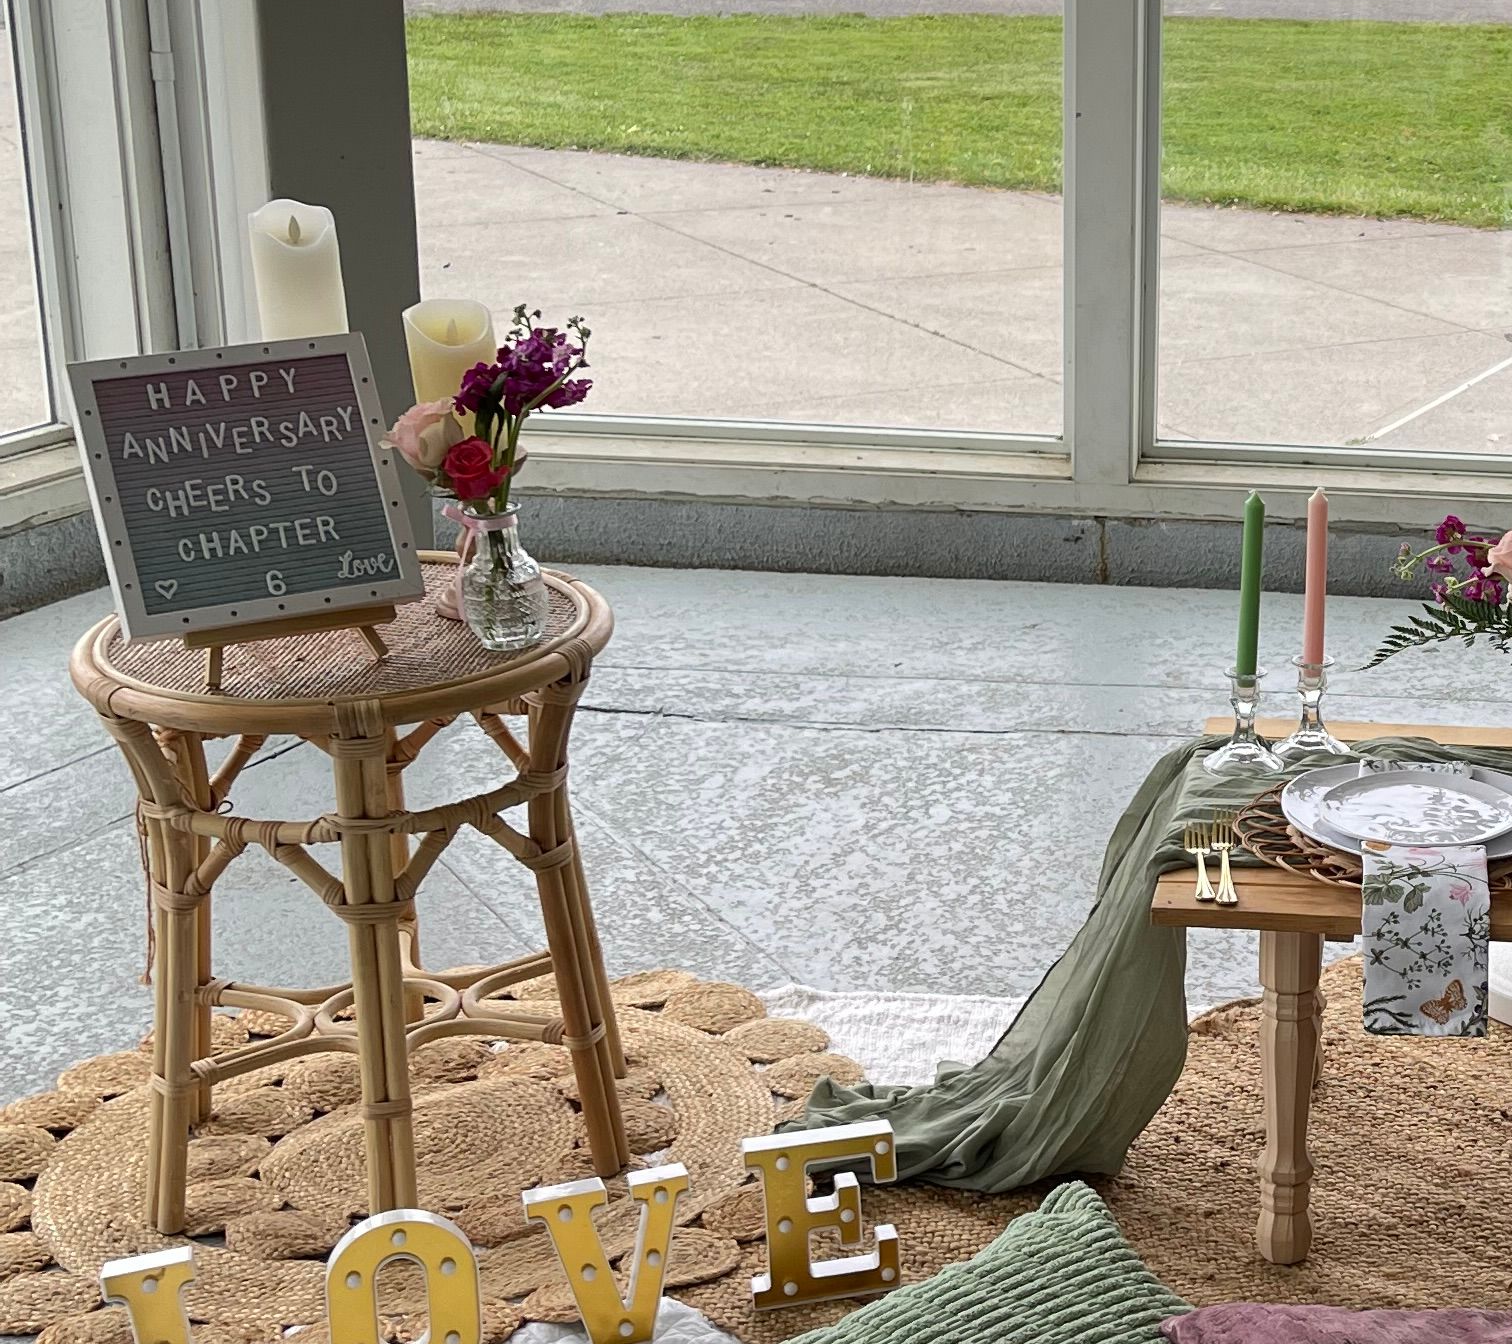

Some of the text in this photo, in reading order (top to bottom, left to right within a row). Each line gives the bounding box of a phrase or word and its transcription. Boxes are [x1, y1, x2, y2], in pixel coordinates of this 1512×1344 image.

[146, 368, 296, 410] HAPPY
[122, 406, 353, 464] ANNIVERSARY
[146, 465, 337, 517] CHEERS TO
[178, 516, 340, 562] CHAPTER
[266, 570, 287, 596] 6
[337, 550, 394, 579] Love
